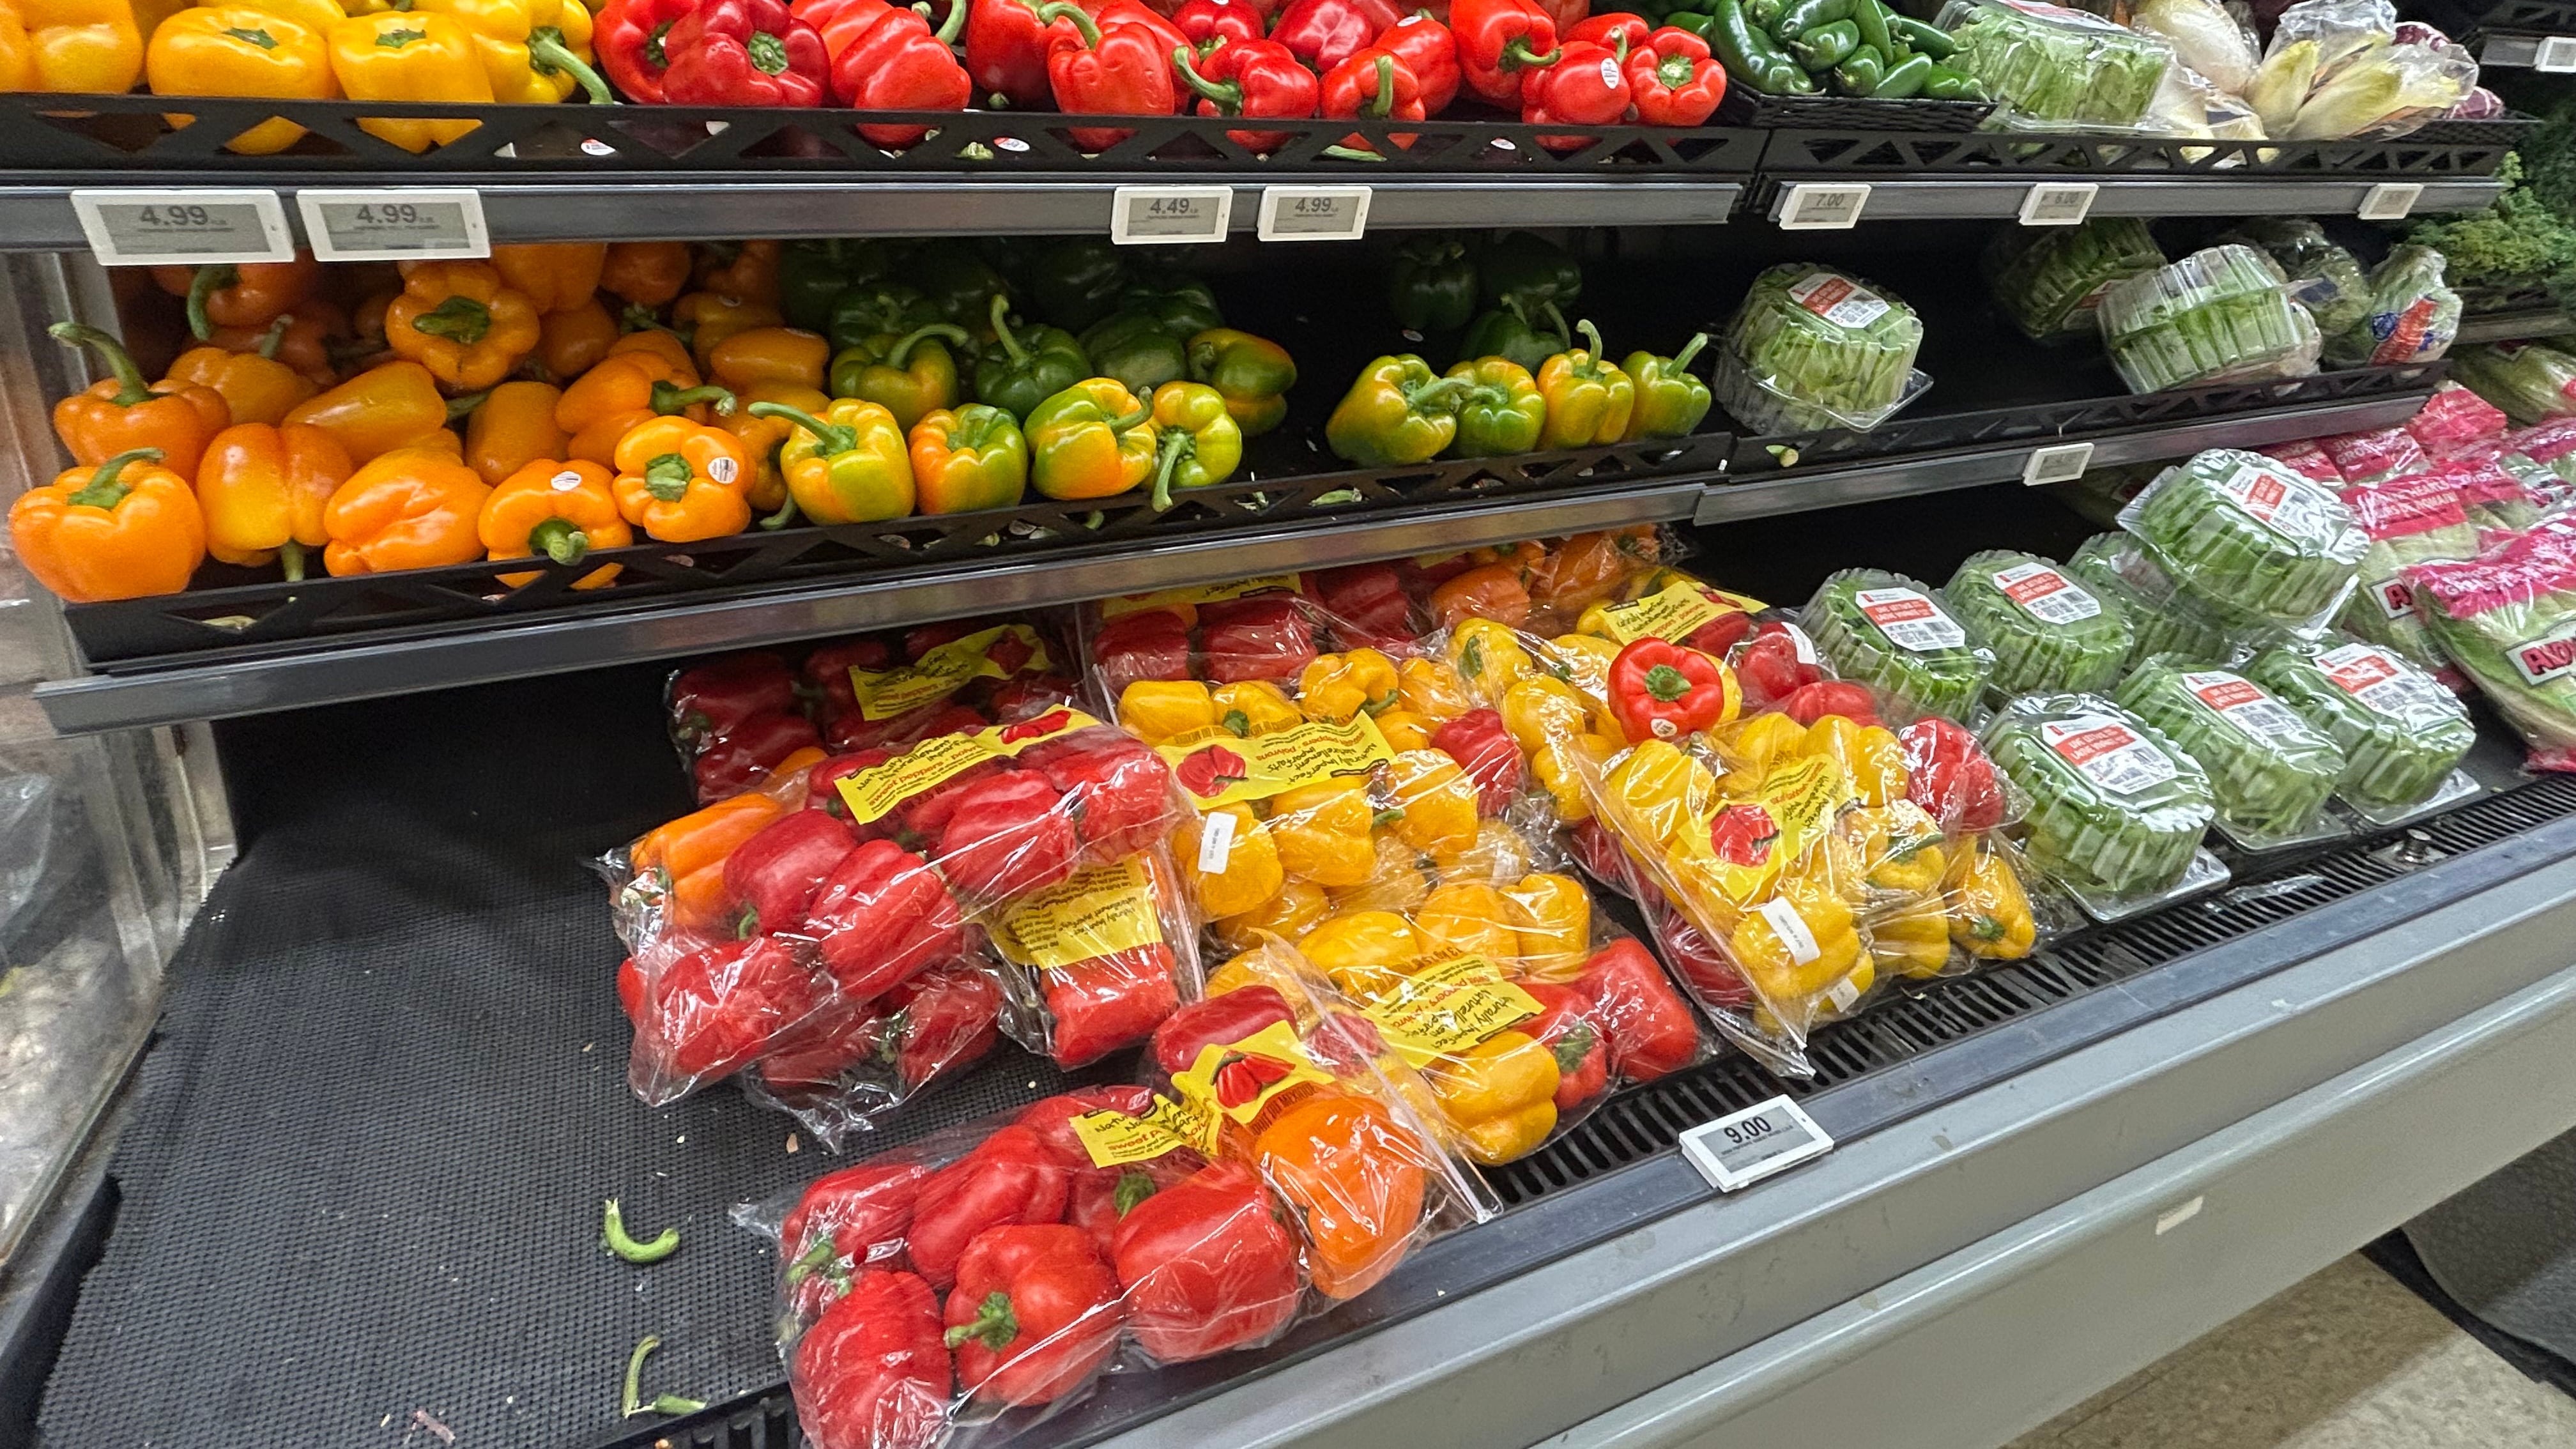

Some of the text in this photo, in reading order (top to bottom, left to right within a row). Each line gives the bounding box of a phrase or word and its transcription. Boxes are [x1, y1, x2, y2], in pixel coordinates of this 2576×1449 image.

[139, 205, 208, 225] 4.99
[356, 204, 417, 224] 4.99
[1149, 198, 1190, 214] 4.49
[1295, 197, 1332, 213] 4.99
[899, 760, 944, 783] peppers
[1724, 1116, 1772, 1144] 9.00
[1108, 1133, 1149, 1151] sweet
